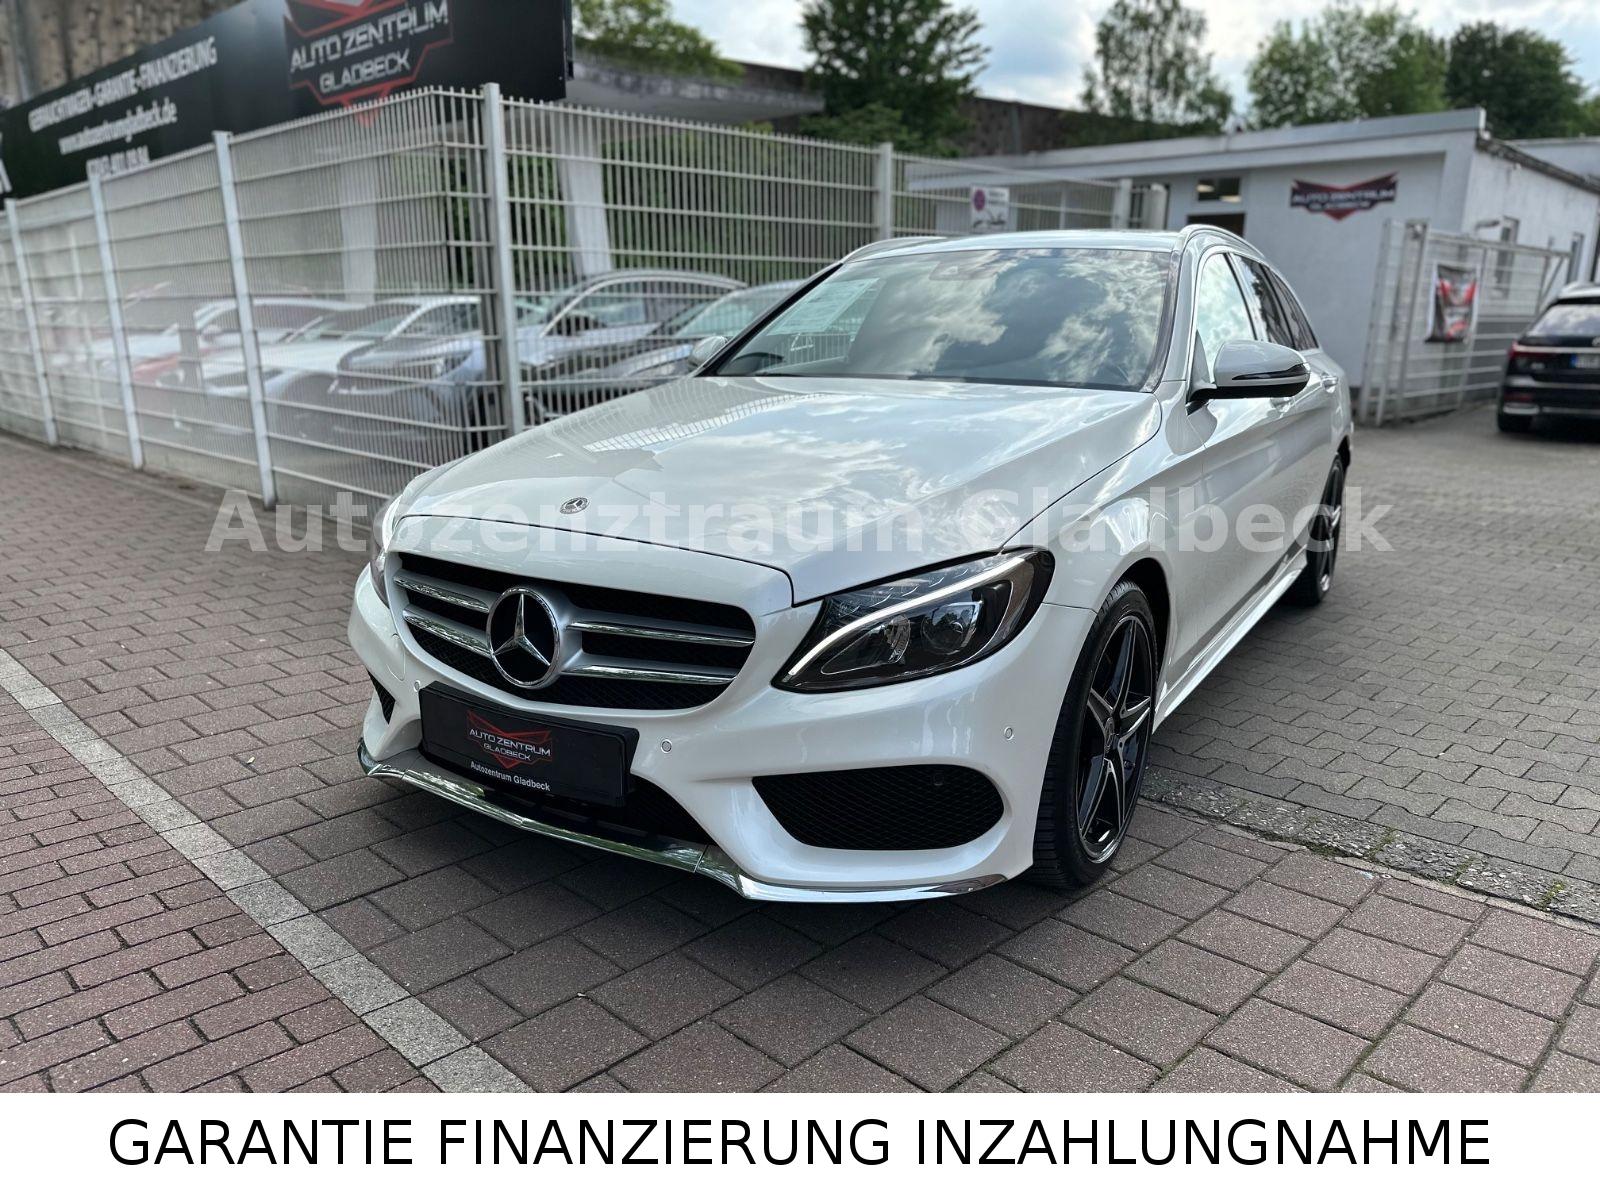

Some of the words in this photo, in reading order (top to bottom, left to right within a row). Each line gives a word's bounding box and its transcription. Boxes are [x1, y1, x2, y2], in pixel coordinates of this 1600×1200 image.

[290, 34, 342, 73] AUTO
[342, 1, 449, 57] ZENTRUM
[319, 48, 411, 93] GLADBECK
[469, 728, 496, 742] AUTO
[496, 737, 551, 757] ZENTRUM
[483, 742, 531, 761] GLADBECK
[470, 760, 512, 782] Autozentrum
[513, 775, 551, 792] Gladbeck
